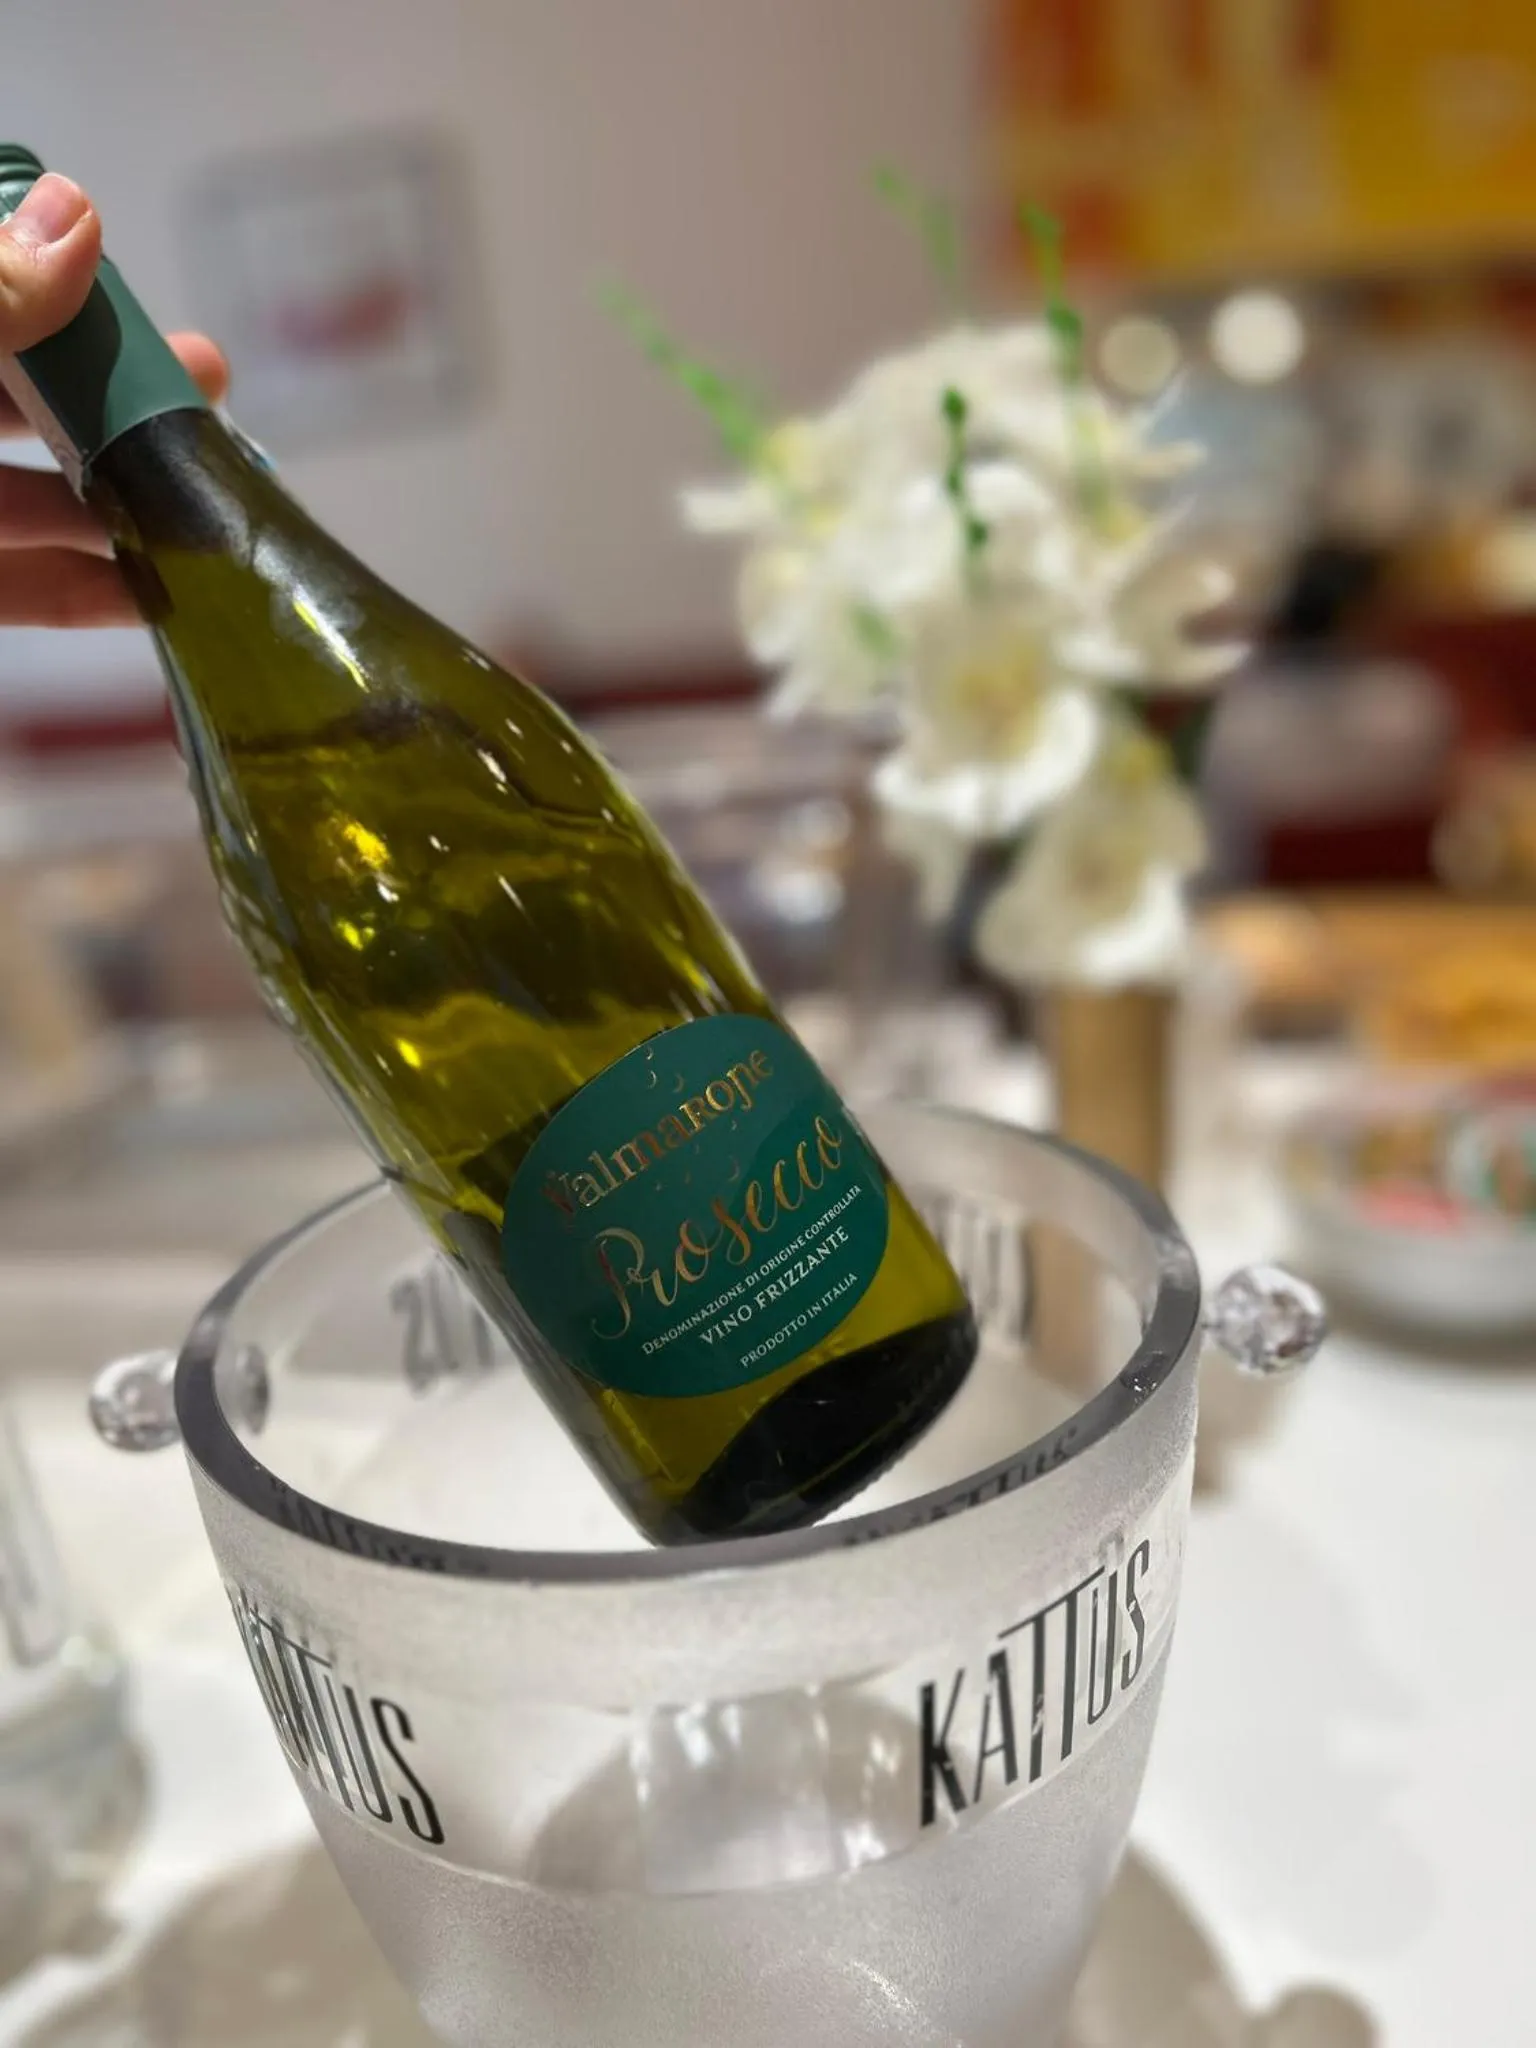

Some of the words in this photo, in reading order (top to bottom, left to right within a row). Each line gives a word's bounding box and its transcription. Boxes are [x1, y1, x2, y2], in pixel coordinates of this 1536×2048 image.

[591, 1115, 843, 1340] Prosecco
[699, 1304, 754, 1346] VINO
[754, 1225, 850, 1311] FRIZZANTE
[746, 1271, 761, 1288] DI
[760, 1235, 806, 1277] ORIGINE
[804, 1184, 863, 1241] CONTROLLATA
[739, 1313, 808, 1369] PRODOTTO
[807, 1301, 823, 1321] IN
[821, 1271, 860, 1308] ITALIA
[227, 1580, 446, 1845] TTUS
[919, 1538, 1151, 1828] KATTUS
